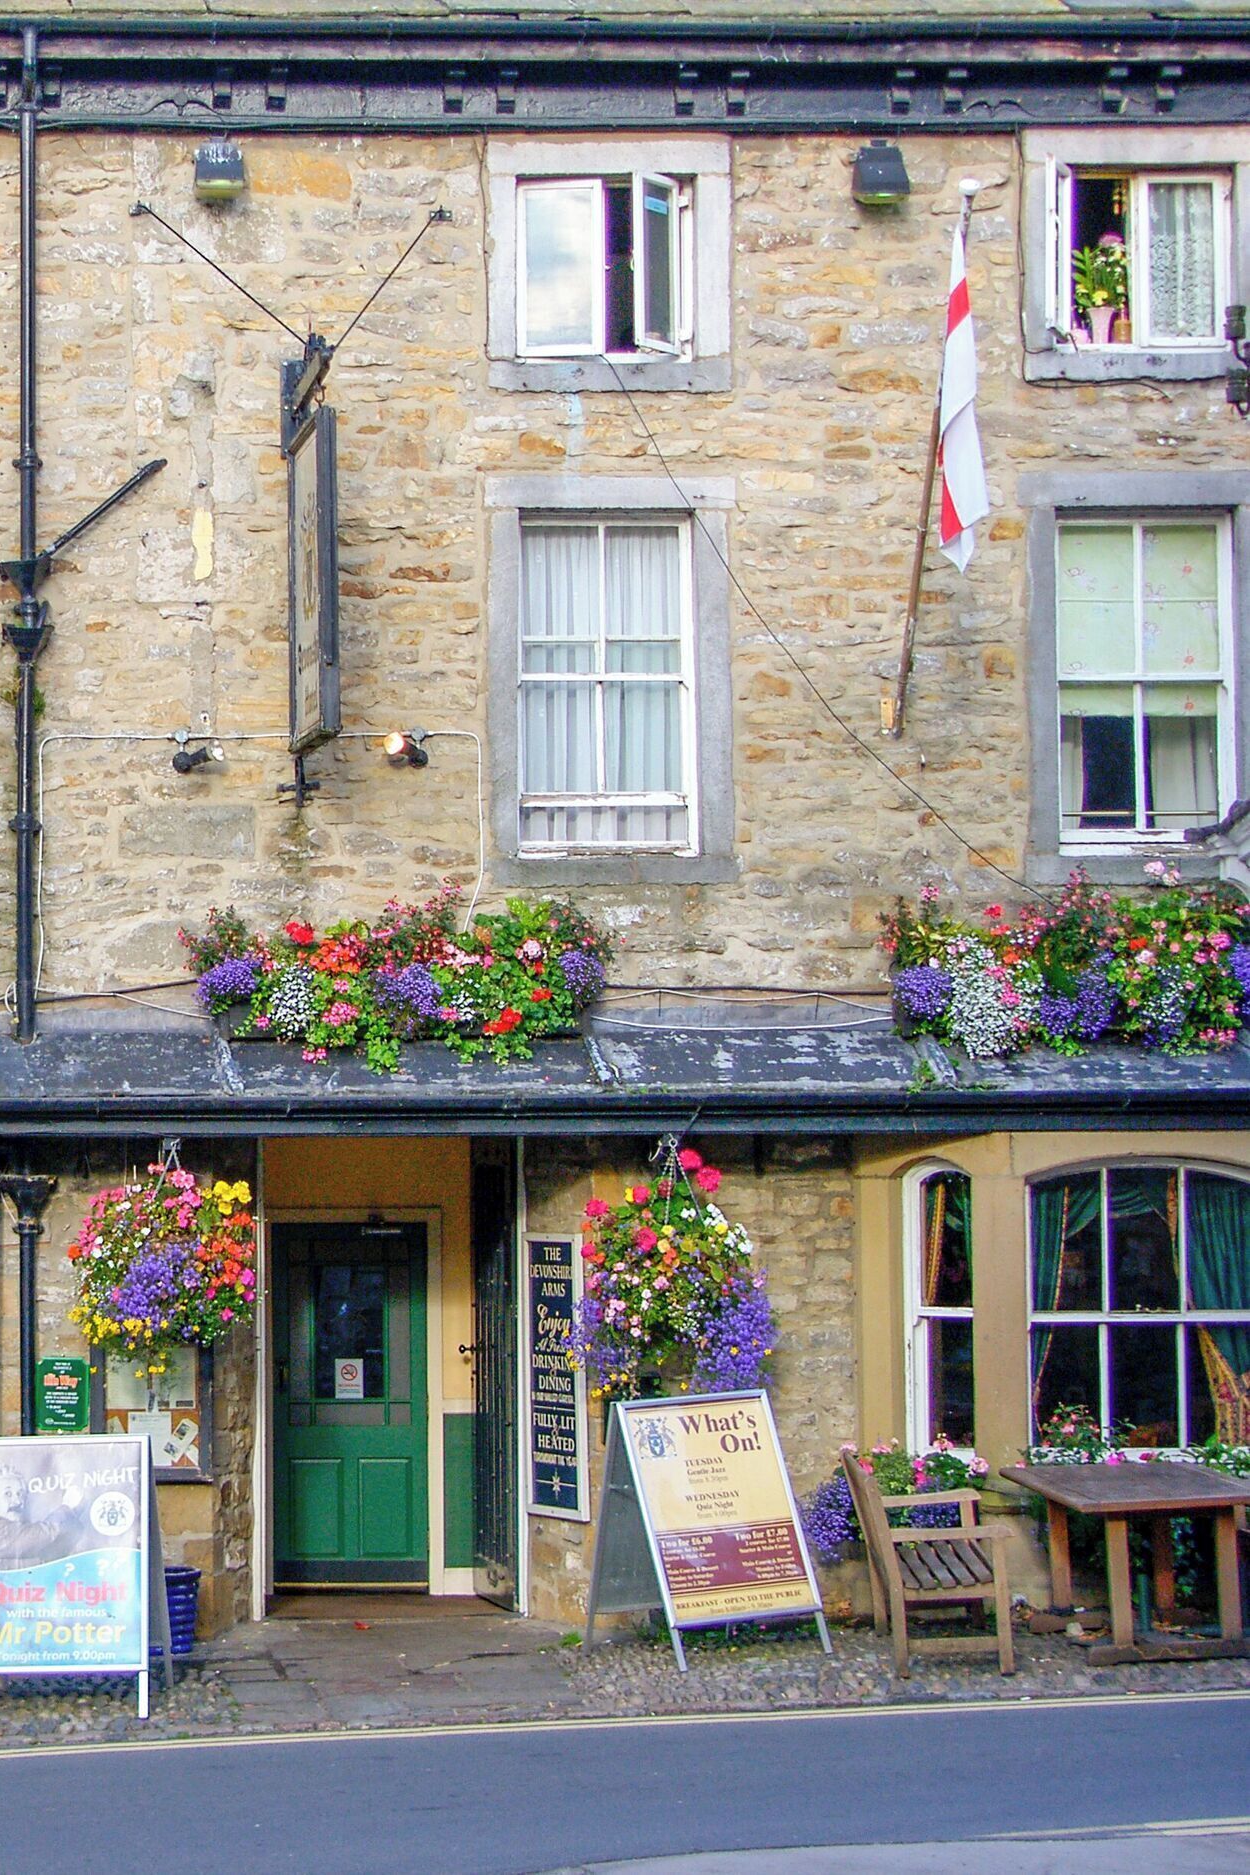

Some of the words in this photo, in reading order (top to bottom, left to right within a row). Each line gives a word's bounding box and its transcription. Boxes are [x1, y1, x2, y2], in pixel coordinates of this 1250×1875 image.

[543, 1247, 562, 1261] THE
[541, 1282, 566, 1297] ARMS
[537, 1303, 570, 1338] Enjoy
[532, 1354, 571, 1371] DRINKIN
[538, 1375, 571, 1392] DINING
[533, 1413, 558, 1428] FULLY
[561, 1416, 576, 1431] LIT
[677, 1410, 757, 1435] What's
[538, 1434, 575, 1451] HEATED
[719, 1431, 762, 1454] On!
[685, 1457, 724, 1468] TUESDAY
[687, 1467, 709, 1476] Gentle
[711, 1466, 726, 1475] Jazz
[685, 1490, 740, 1503] WEDNESDAY
[696, 1501, 713, 1511] Quiz
[714, 1500, 734, 1510] Night
[752, 1531, 765, 1539] for
[661, 1540, 678, 1549] Two
[678, 1538, 690, 1547] for
[56, 1580, 127, 1608] Night
[676, 1599, 719, 1610] BREAKFAST
[724, 1597, 746, 1605] OPEN
[775, 1589, 803, 1600] PUBLIC
[7, 1607, 35, 1619] with
[37, 1607, 58, 1619] the
[61, 1606, 107, 1618] famous
[34, 1621, 126, 1645] Potter
[42, 1651, 70, 1662] from
[72, 1651, 116, 1663] 9.00pm
